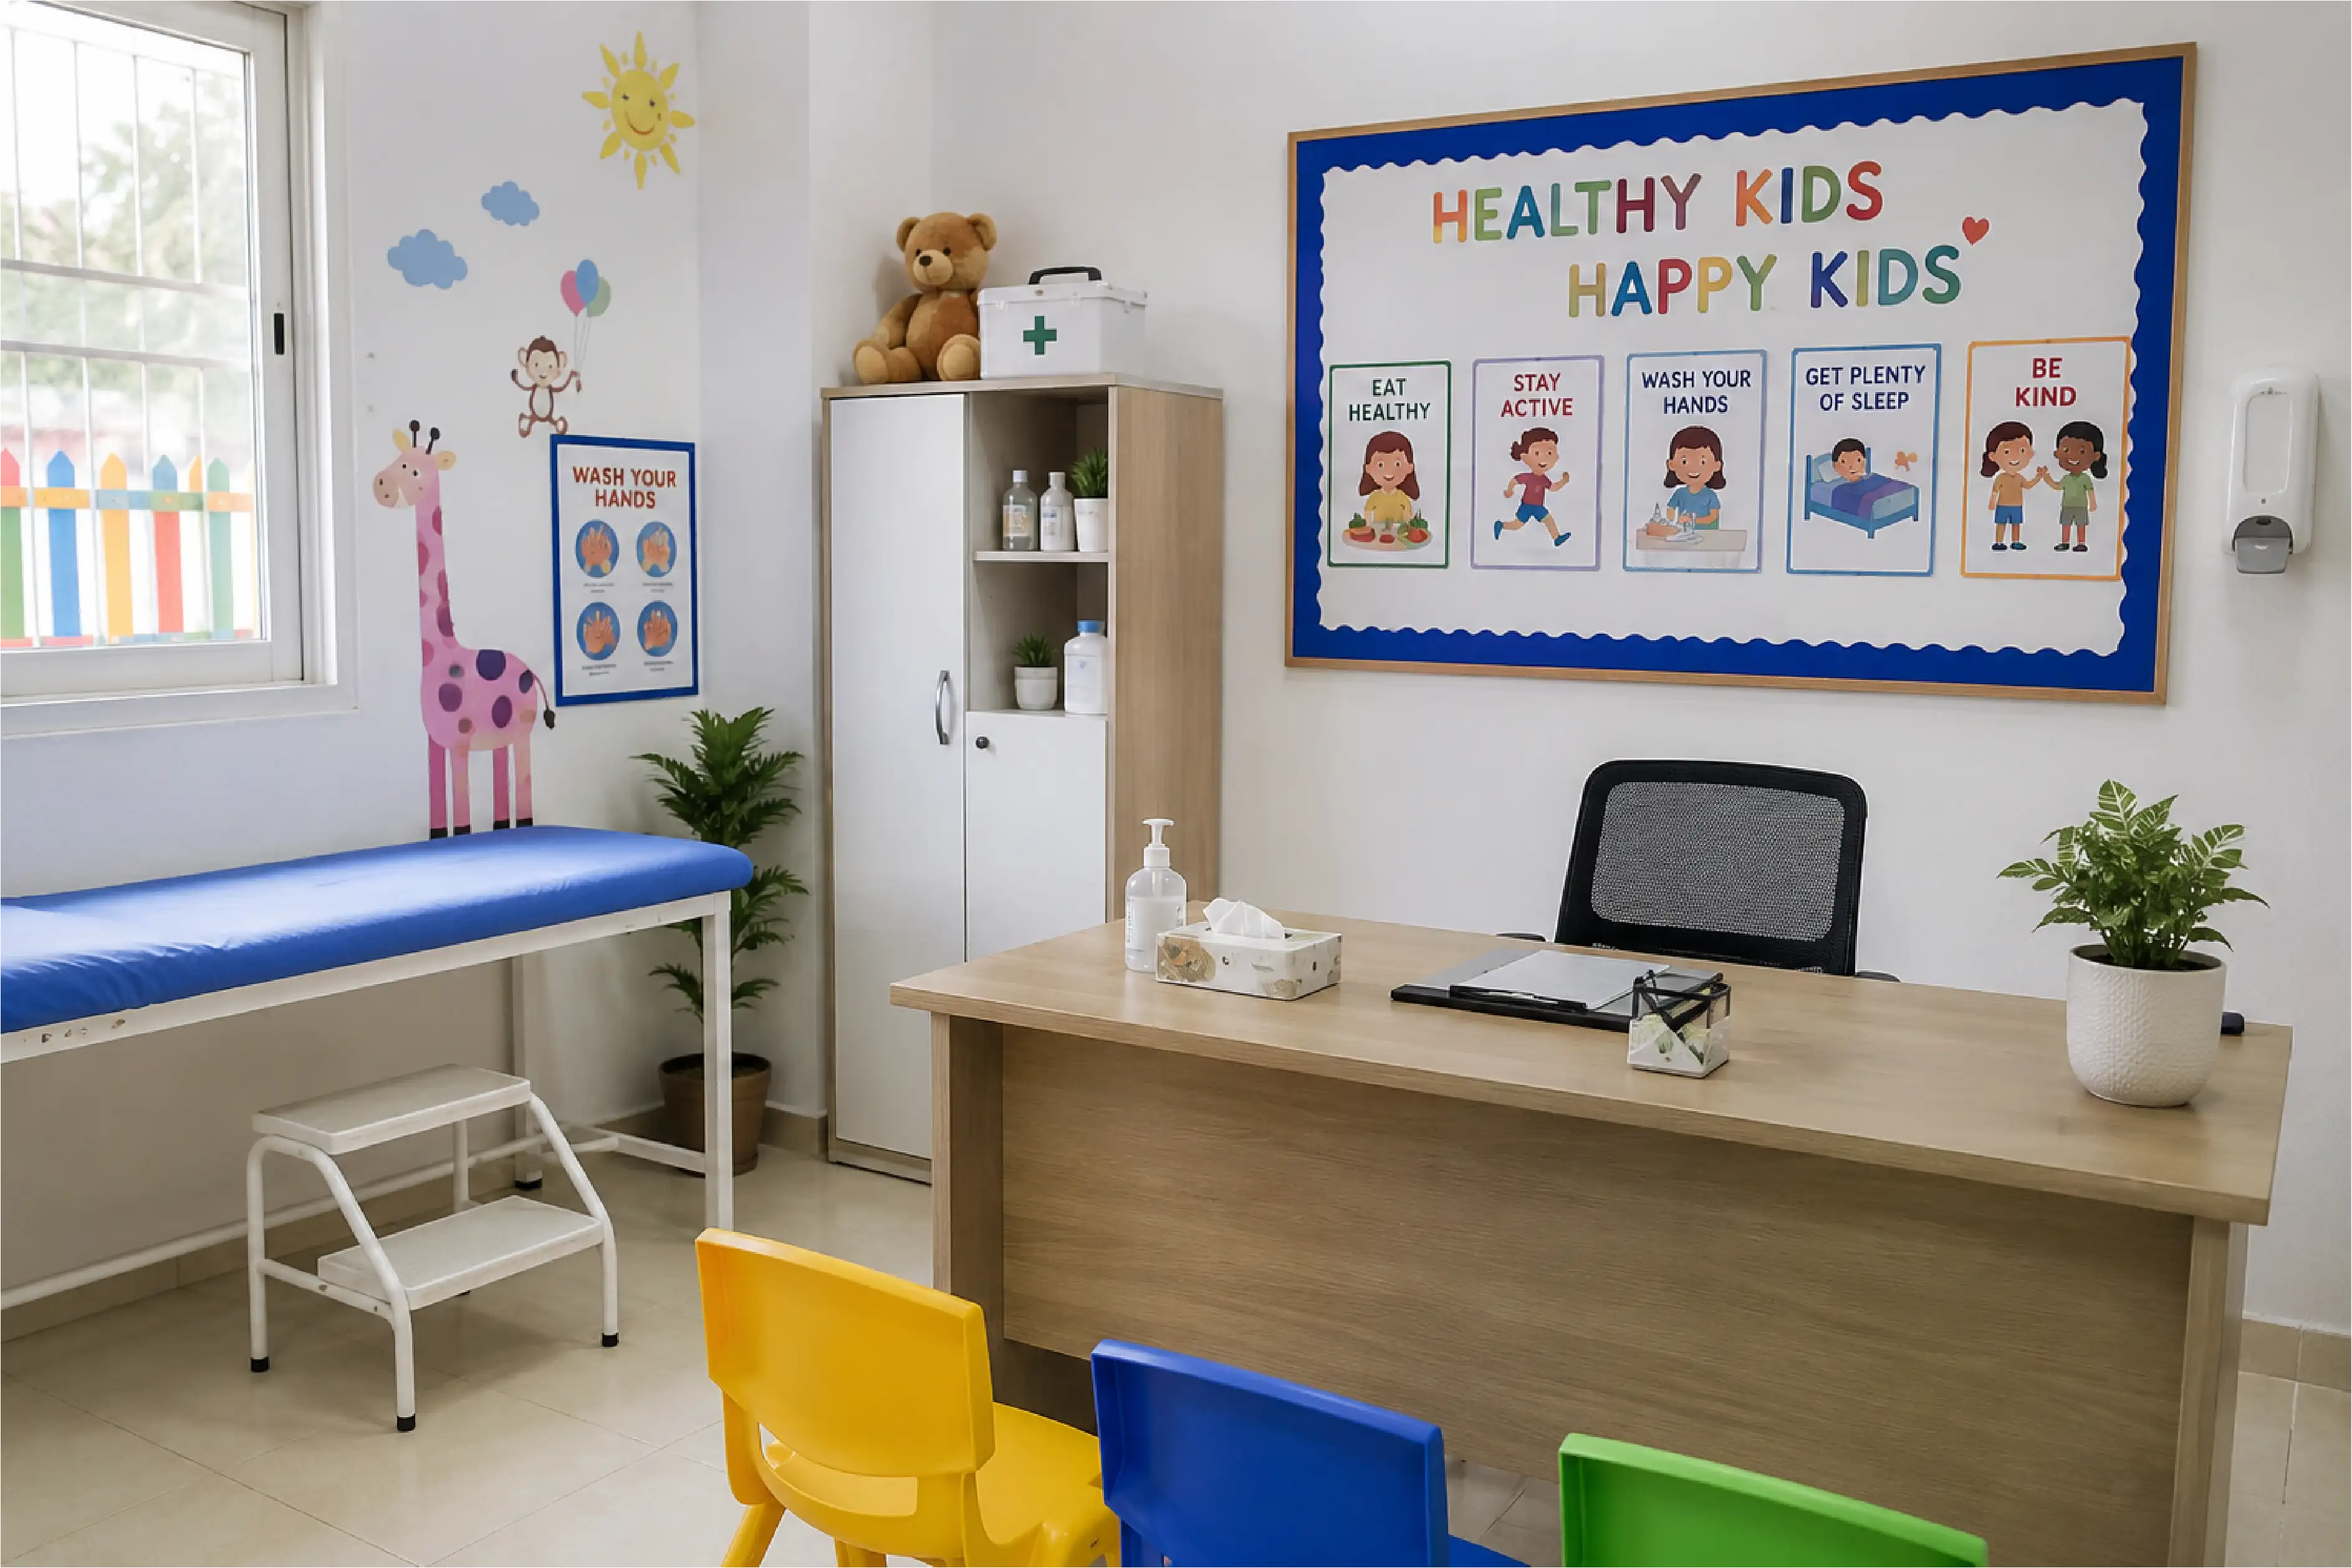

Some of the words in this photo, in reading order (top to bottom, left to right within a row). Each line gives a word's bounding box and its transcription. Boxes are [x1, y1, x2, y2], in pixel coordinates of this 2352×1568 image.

[1433, 173, 1702, 244] HEALTHY
[1736, 161, 1883, 226] KIDS
[1569, 254, 1777, 317] HAPPY
[1810, 246, 1961, 308] KIDS
[1807, 368, 1844, 385] GET
[1851, 365, 1926, 385] PLENTY
[2033, 358, 2062, 378] BE
[1373, 378, 1407, 396] EAT
[1514, 373, 1560, 391] STAY
[1643, 371, 1695, 388] WASH
[1702, 369, 1752, 388] YOUR
[1664, 395, 1728, 414] HANDS
[1820, 392, 1845, 411] OF
[1852, 392, 1909, 410] SLEEP
[2016, 387, 2076, 407] KIND
[1349, 403, 1430, 421] HEALTHY
[1501, 398, 1573, 417] ACTIVE
[572, 466, 623, 485] WASH
[631, 469, 676, 487] YOUR
[596, 489, 656, 509] HANDS
